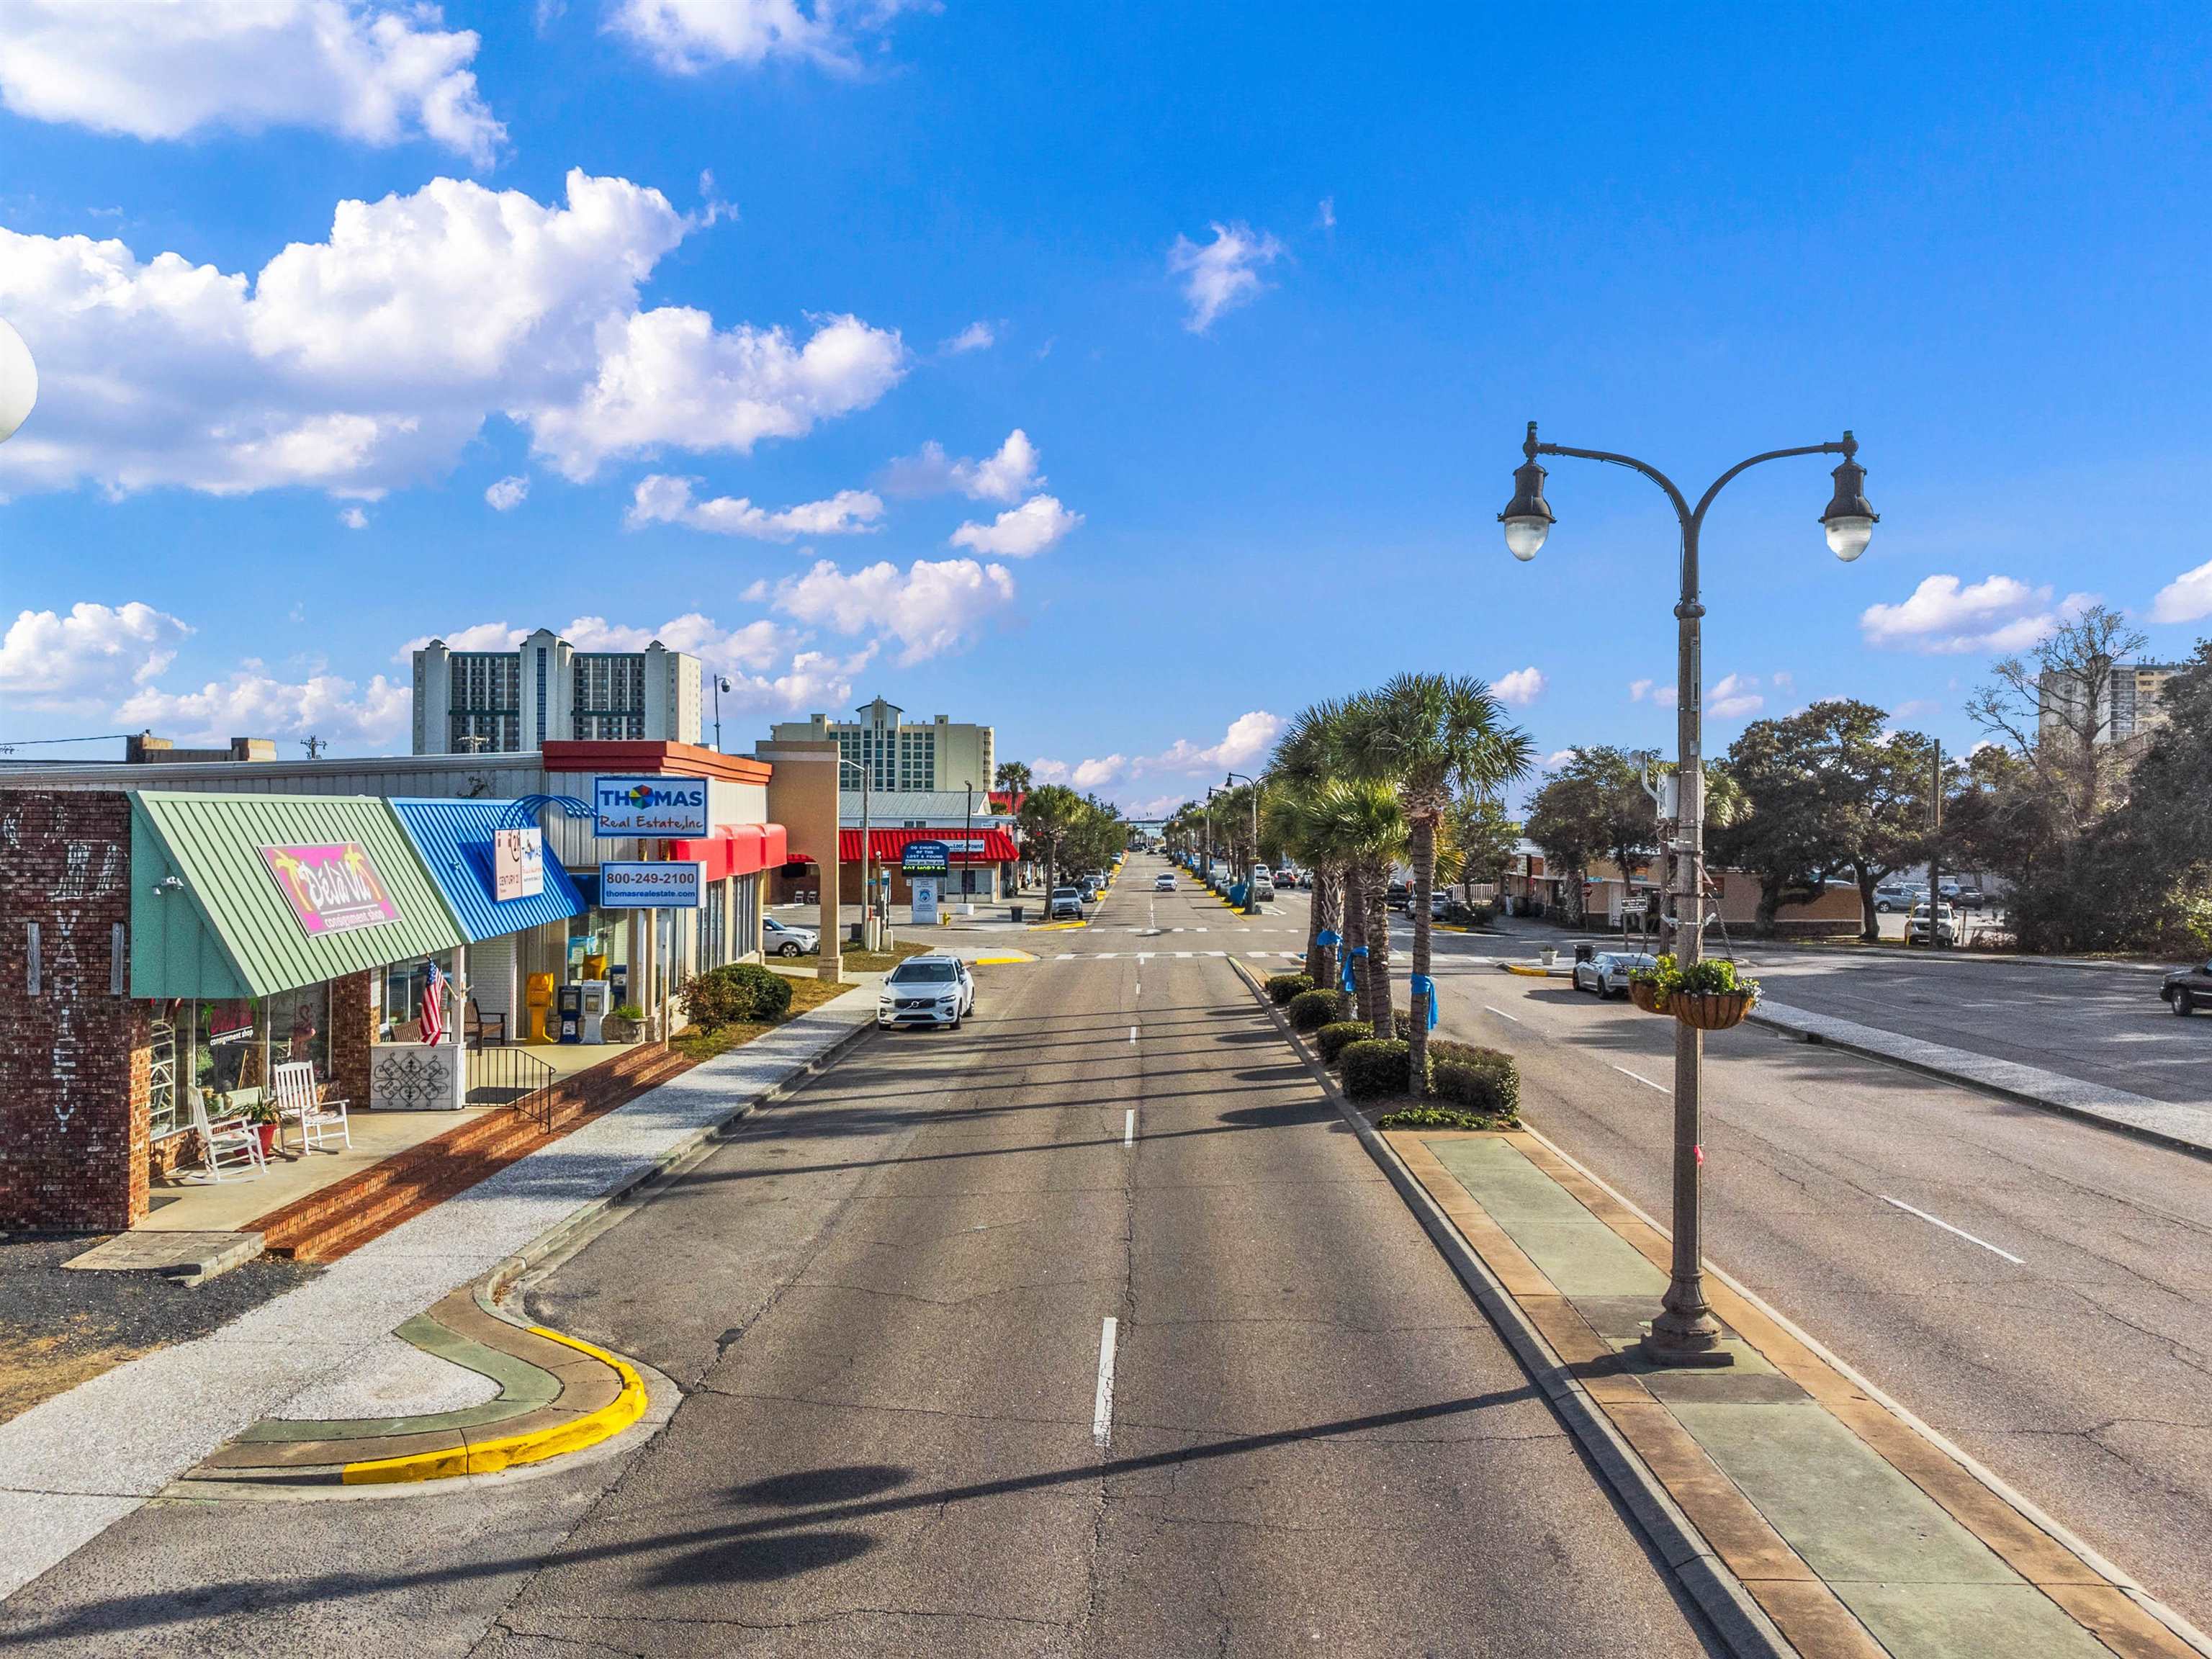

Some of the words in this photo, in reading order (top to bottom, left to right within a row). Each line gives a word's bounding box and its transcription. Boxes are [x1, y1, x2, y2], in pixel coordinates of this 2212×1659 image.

[599, 785, 703, 809] THOMAS
[599, 814, 630, 828] Real
[606, 873, 695, 884] 800-249-2100
[324, 912, 369, 929] consignment
[368, 908, 385, 922] shop
